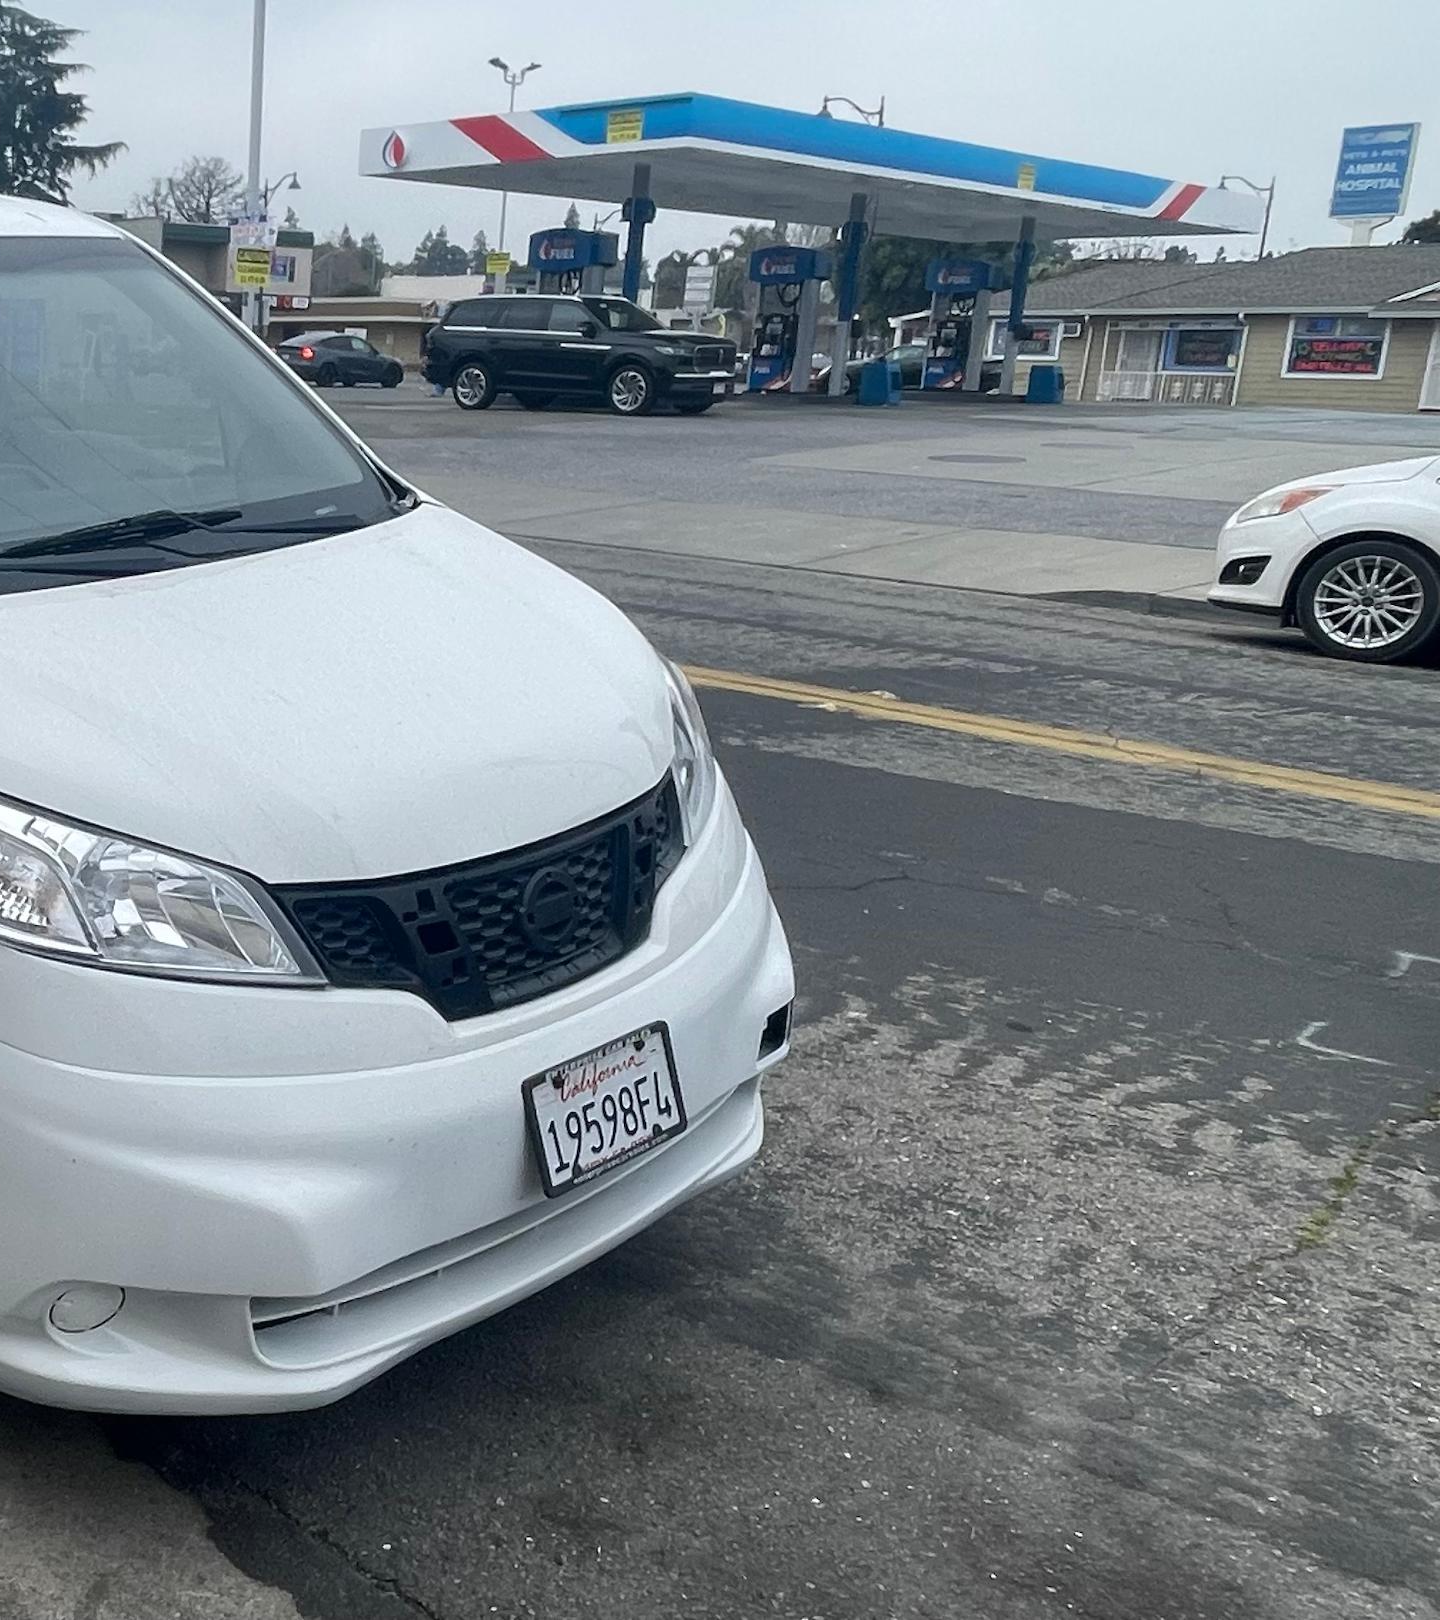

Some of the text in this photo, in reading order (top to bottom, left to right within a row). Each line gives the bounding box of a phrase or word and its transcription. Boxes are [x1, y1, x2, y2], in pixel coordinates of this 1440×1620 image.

[1345, 162, 1398, 175] ANIMAL
[1335, 178, 1401, 191] HOSPITAL
[551, 248, 575, 260] FUEL
[561, 1056, 645, 1102] California
[547, 1071, 672, 1173] 19598F4
